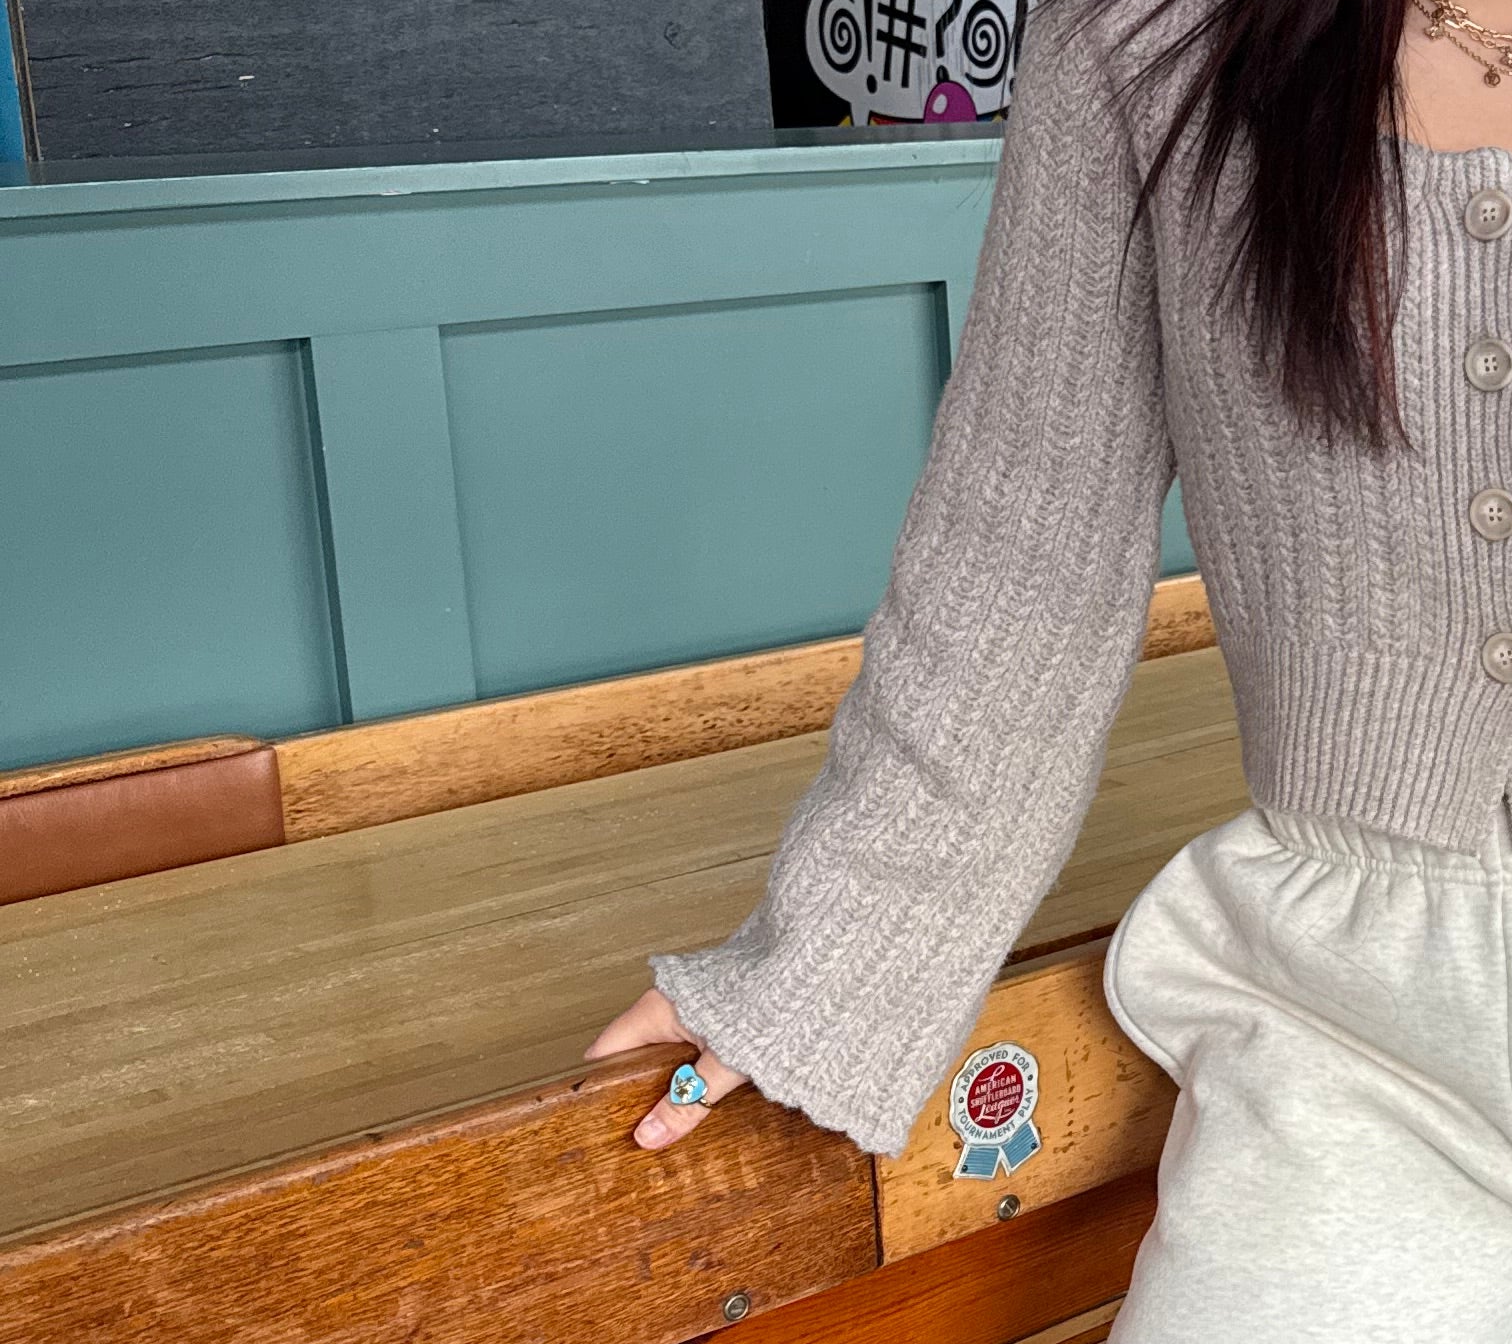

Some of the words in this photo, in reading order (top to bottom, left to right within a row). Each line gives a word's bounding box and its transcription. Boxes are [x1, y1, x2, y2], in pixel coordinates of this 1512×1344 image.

[961, 1050, 1009, 1092] APPROVED
[1012, 1053, 1030, 1072] FOR
[975, 1074, 1017, 1096] AMERICAN
[970, 1084, 1022, 1108] SHUFFLEBOARD
[958, 1108, 1016, 1140] TOURNAMENT
[1017, 1088, 1034, 1118] PLAY
